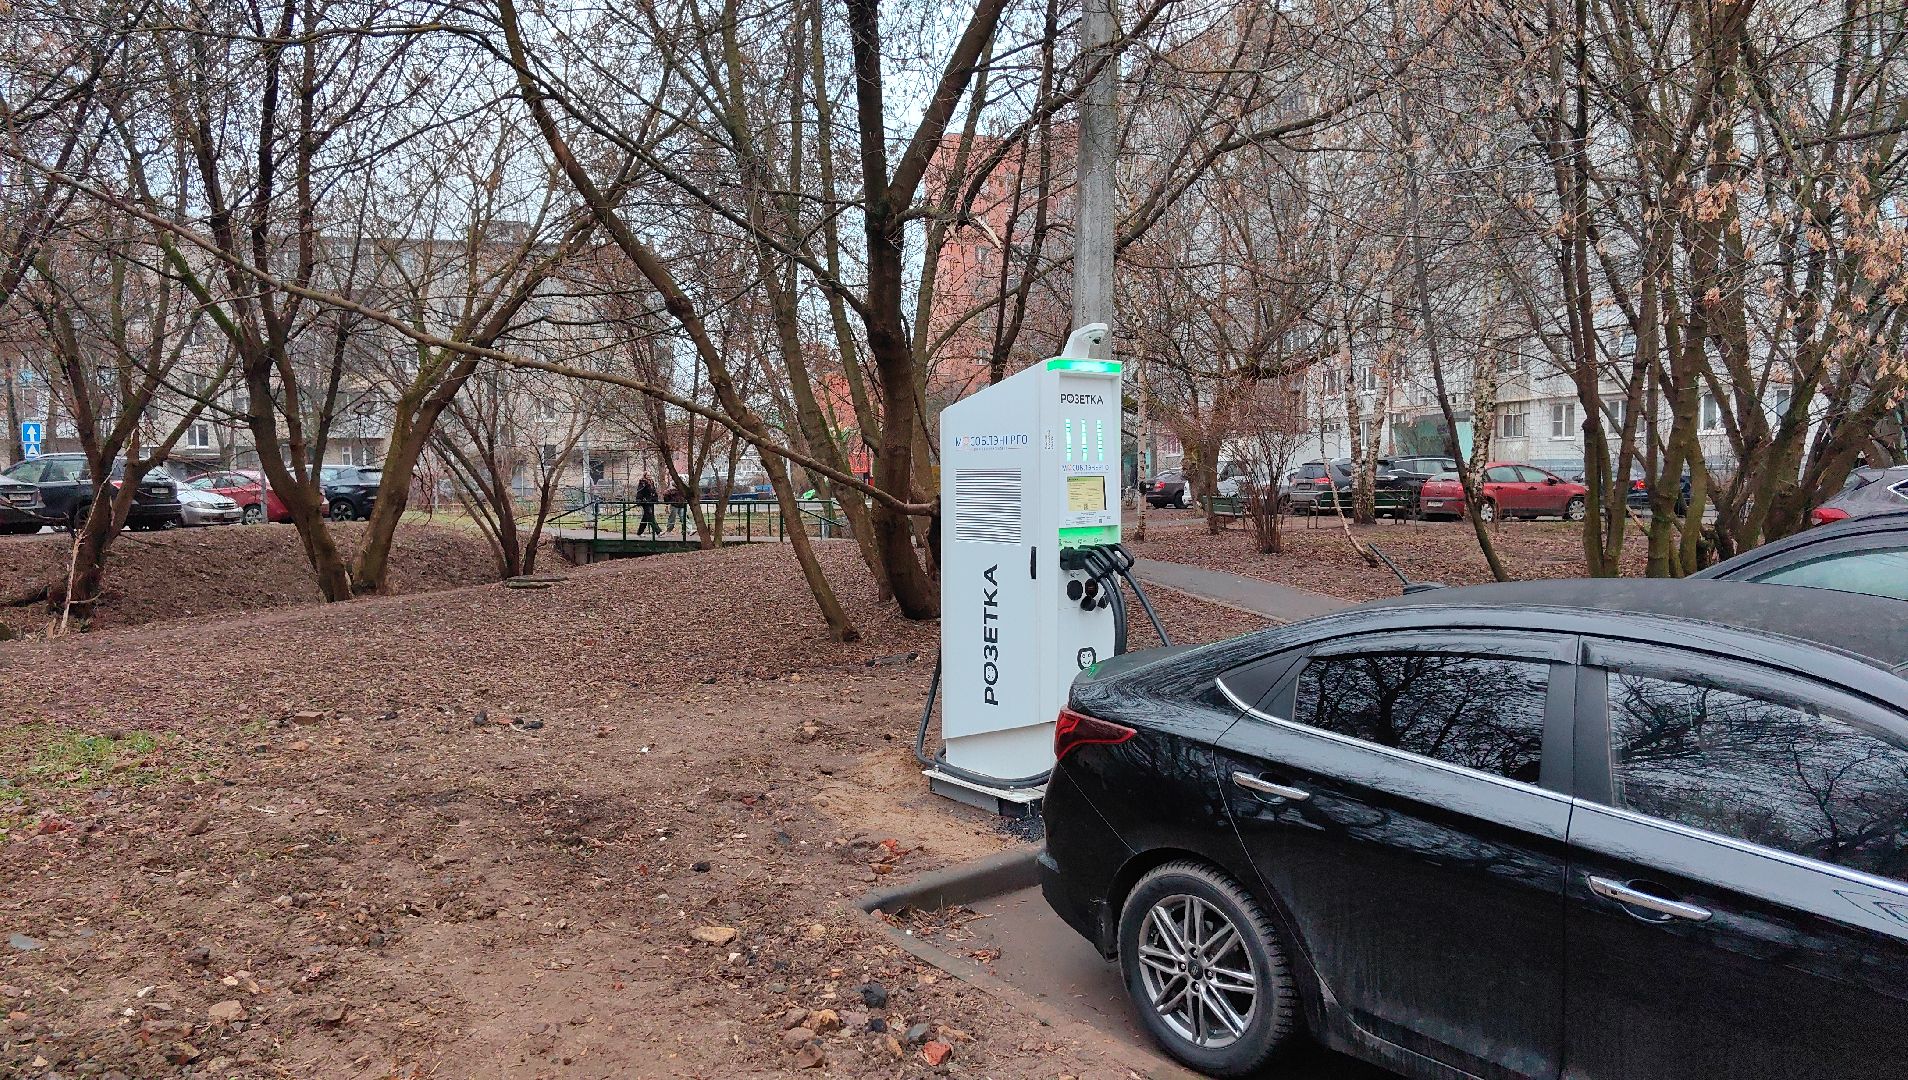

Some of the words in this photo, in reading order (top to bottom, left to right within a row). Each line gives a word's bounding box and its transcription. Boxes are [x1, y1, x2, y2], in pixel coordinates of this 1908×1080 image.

[1060, 393, 1104, 405] РОЗЕТКА
[1062, 464, 1110, 472] МОСОБЛЭНО
[983, 563, 999, 706] РОЗЕТКА
